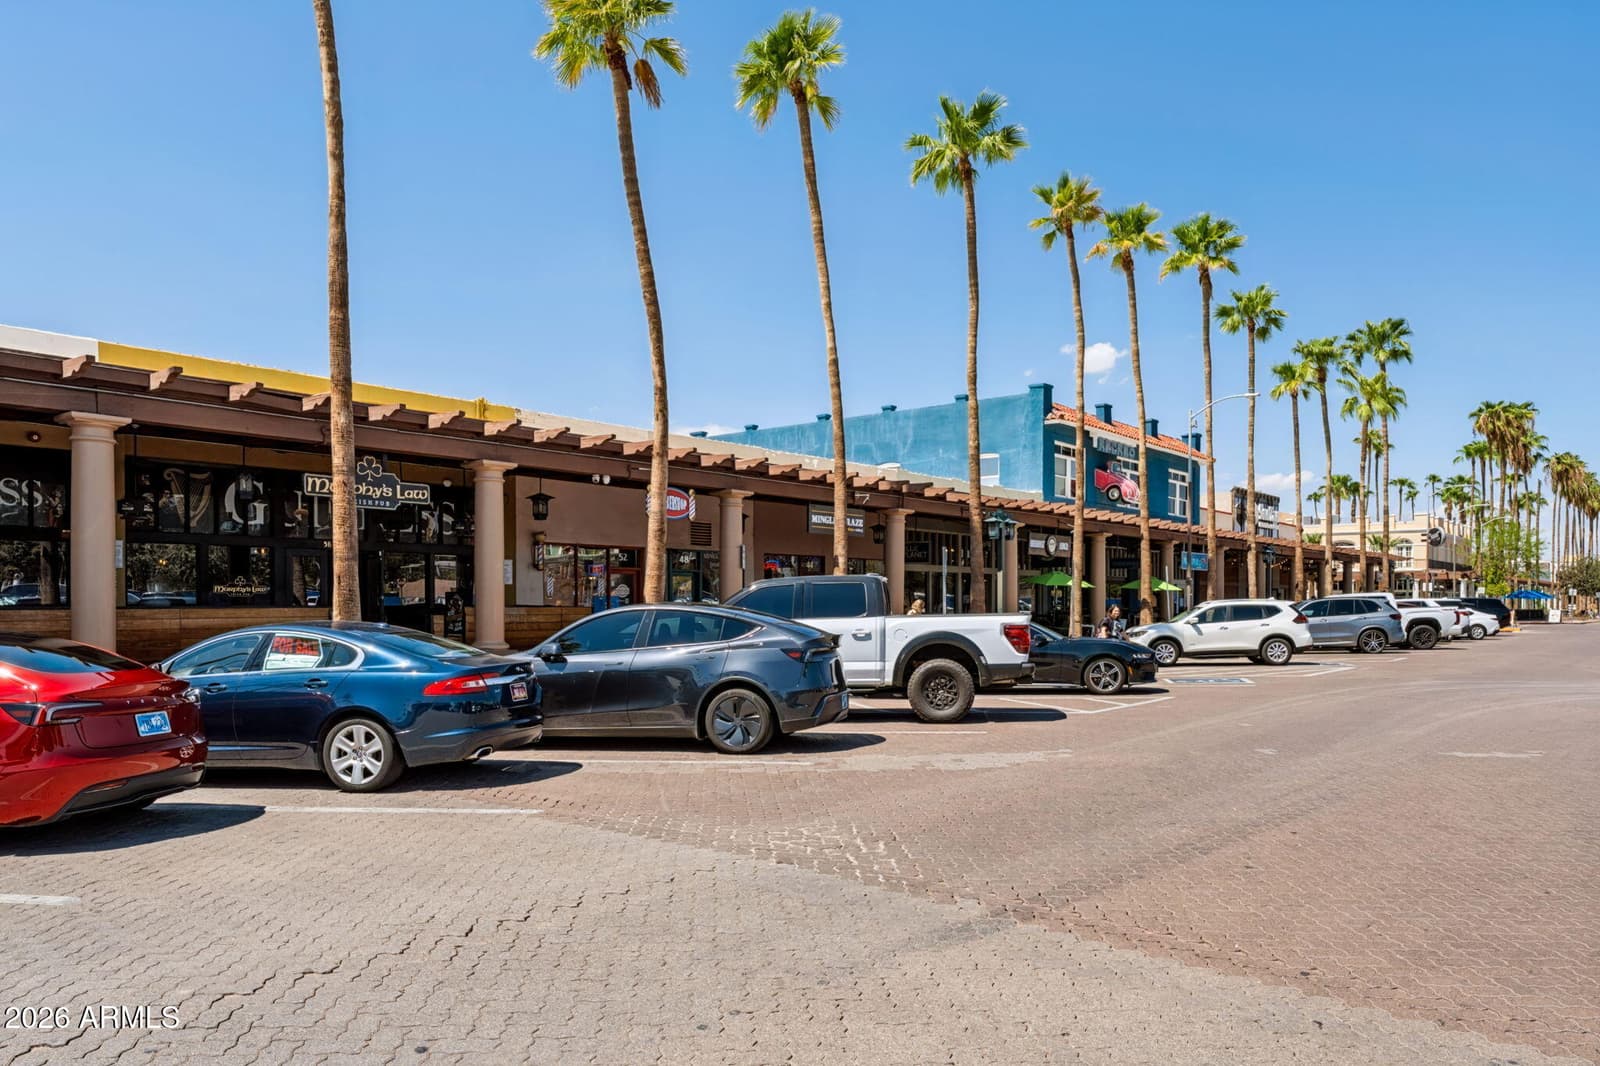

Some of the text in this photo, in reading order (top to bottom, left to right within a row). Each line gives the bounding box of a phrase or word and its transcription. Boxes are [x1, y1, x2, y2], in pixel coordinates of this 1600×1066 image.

[307, 476, 428, 499] Mphy's Law
[811, 514, 836, 525] MINGL
[618, 553, 628, 562] 52
[271, 636, 319, 656] FOR SALE
